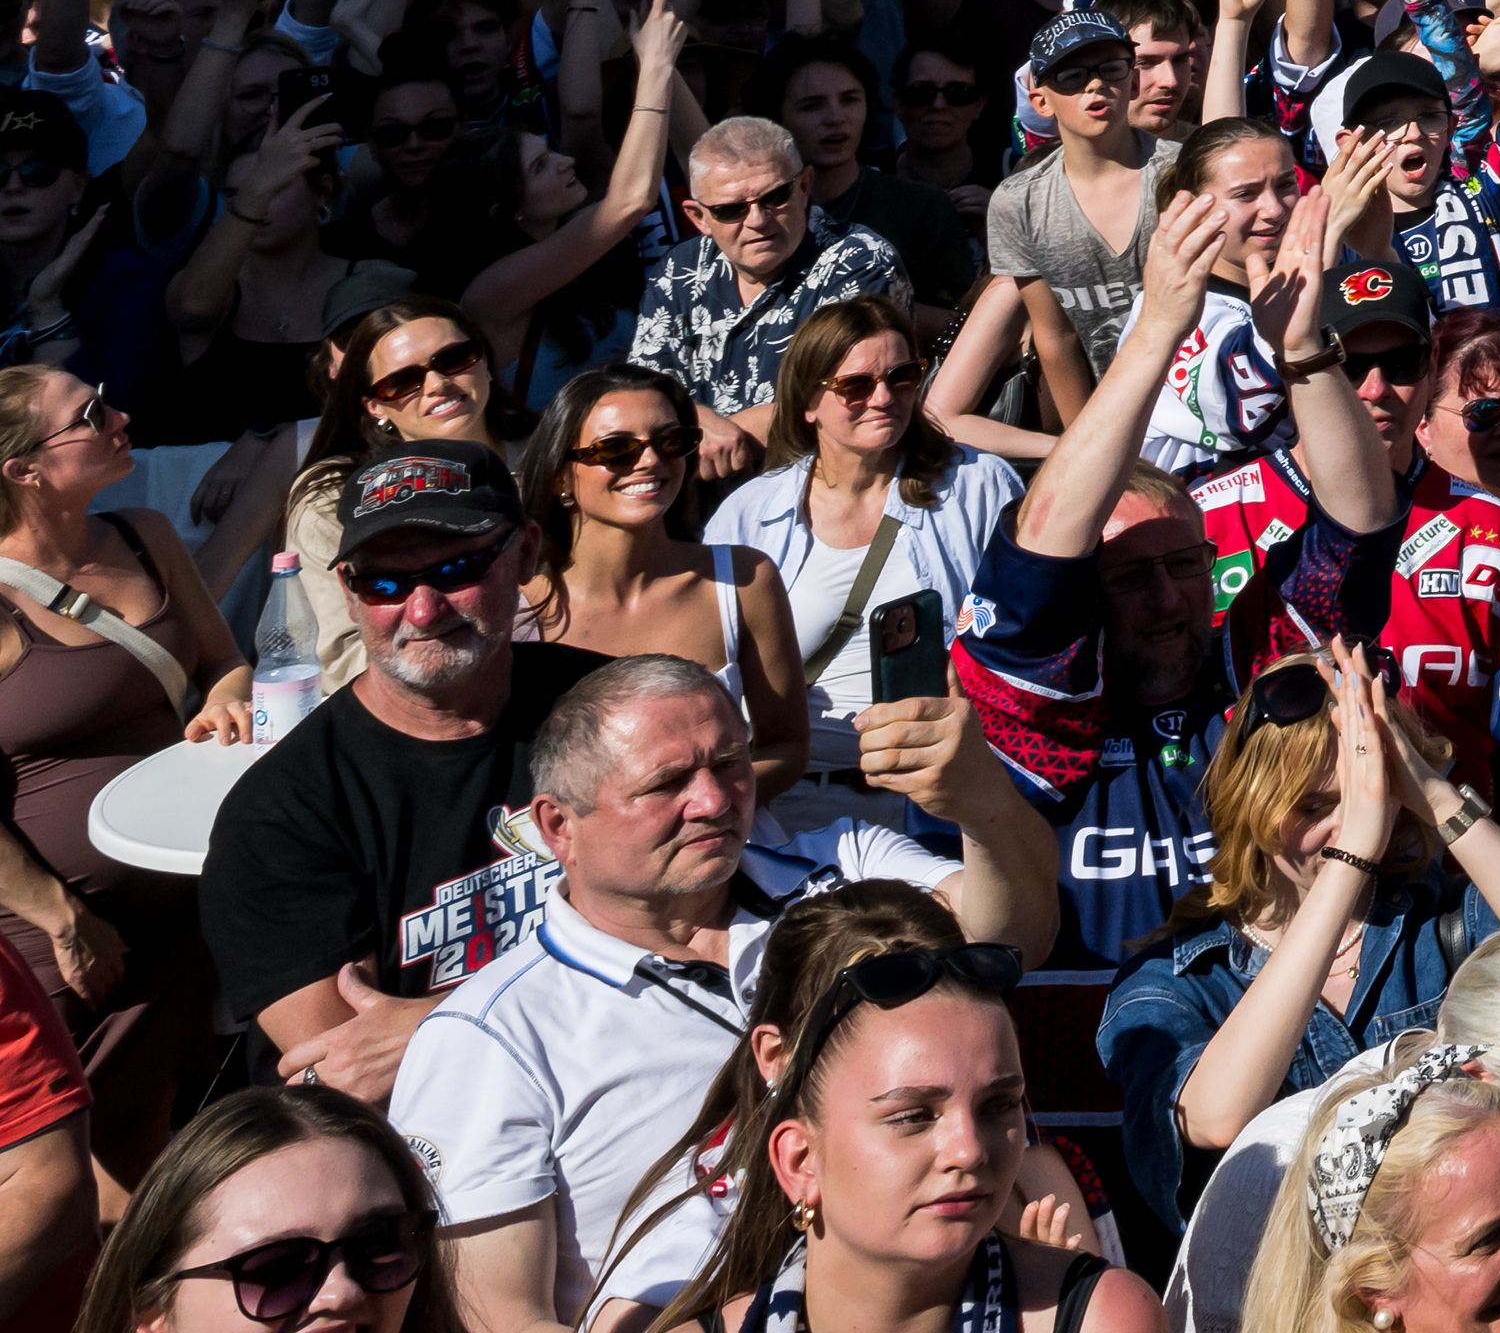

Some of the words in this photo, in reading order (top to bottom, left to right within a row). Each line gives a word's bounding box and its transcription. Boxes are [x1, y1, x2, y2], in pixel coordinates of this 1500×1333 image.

[310, 73, 330, 87] 93
[1206, 470, 1262, 501] HEIDEN
[440, 851, 537, 904] DEUTSCHER
